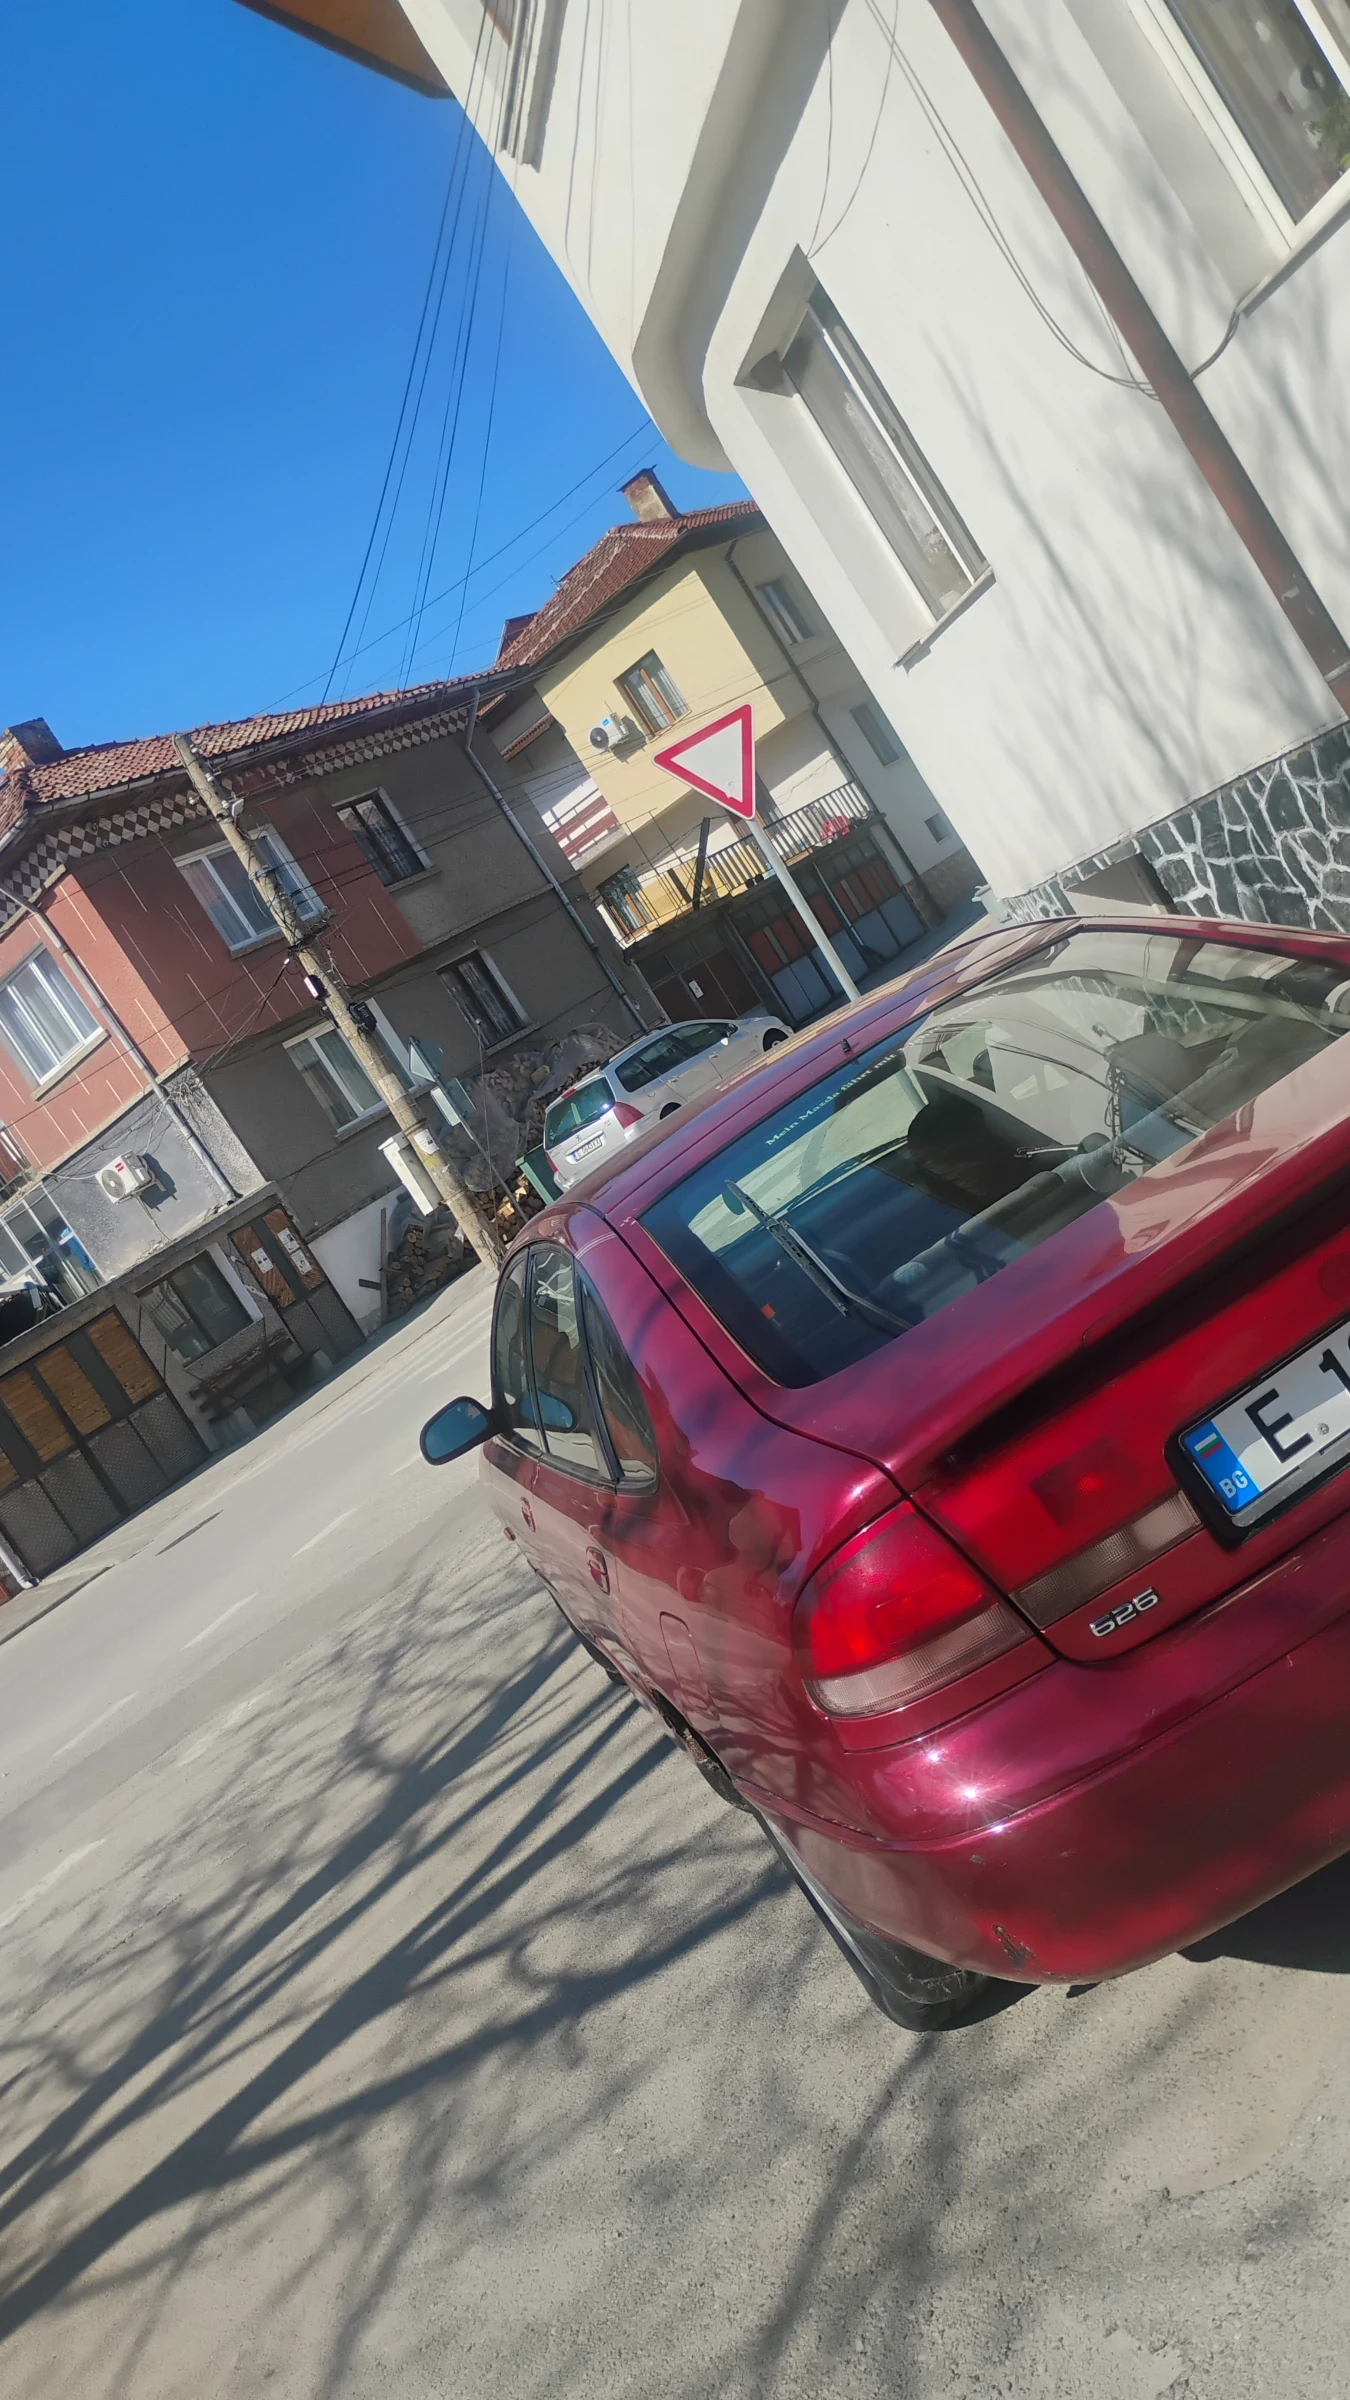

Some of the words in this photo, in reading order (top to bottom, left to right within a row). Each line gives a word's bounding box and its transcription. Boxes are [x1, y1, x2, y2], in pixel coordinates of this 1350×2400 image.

[765, 1121, 799, 1146] Mein
[798, 1092, 840, 1121] Mazda
[873, 1053, 897, 1069] mit
[1244, 1388, 1314, 1464] E
[1318, 1334, 1350, 1395] 1
[1219, 1470, 1249, 1499] BG
[1089, 1586, 1159, 1637] 626
